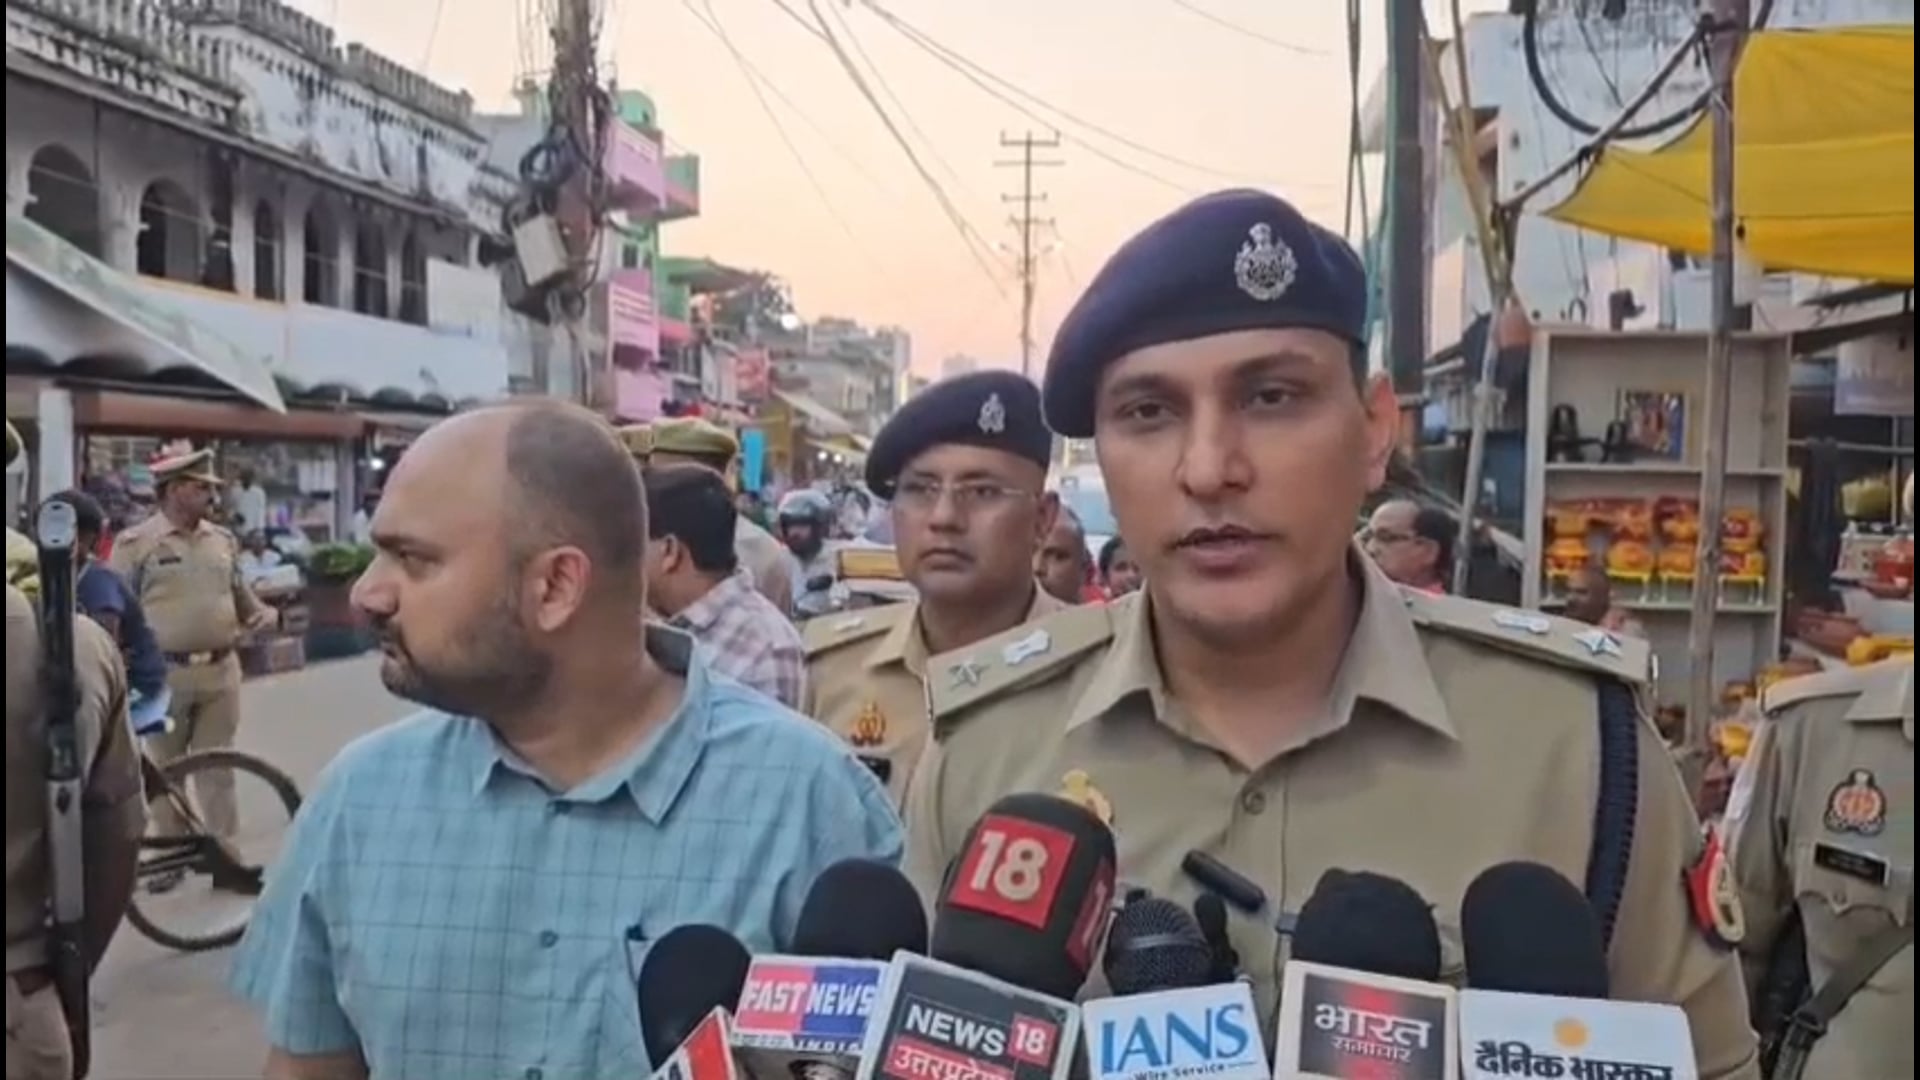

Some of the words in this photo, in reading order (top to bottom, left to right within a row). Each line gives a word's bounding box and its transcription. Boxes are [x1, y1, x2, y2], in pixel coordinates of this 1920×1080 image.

[970, 829, 1049, 901] 18
[742, 980, 807, 1015] FAST
[806, 981, 877, 1017] NEWS
[905, 1004, 1006, 1056] NEWS
[1014, 1022, 1047, 1055] 18
[1101, 1003, 1249, 1074] IANS
[1314, 1002, 1432, 1049] भारत
[1172, 1063, 1225, 1077] Service
[1331, 1035, 1412, 1063] समाचार
[1475, 1040, 1565, 1079] दैनिक
